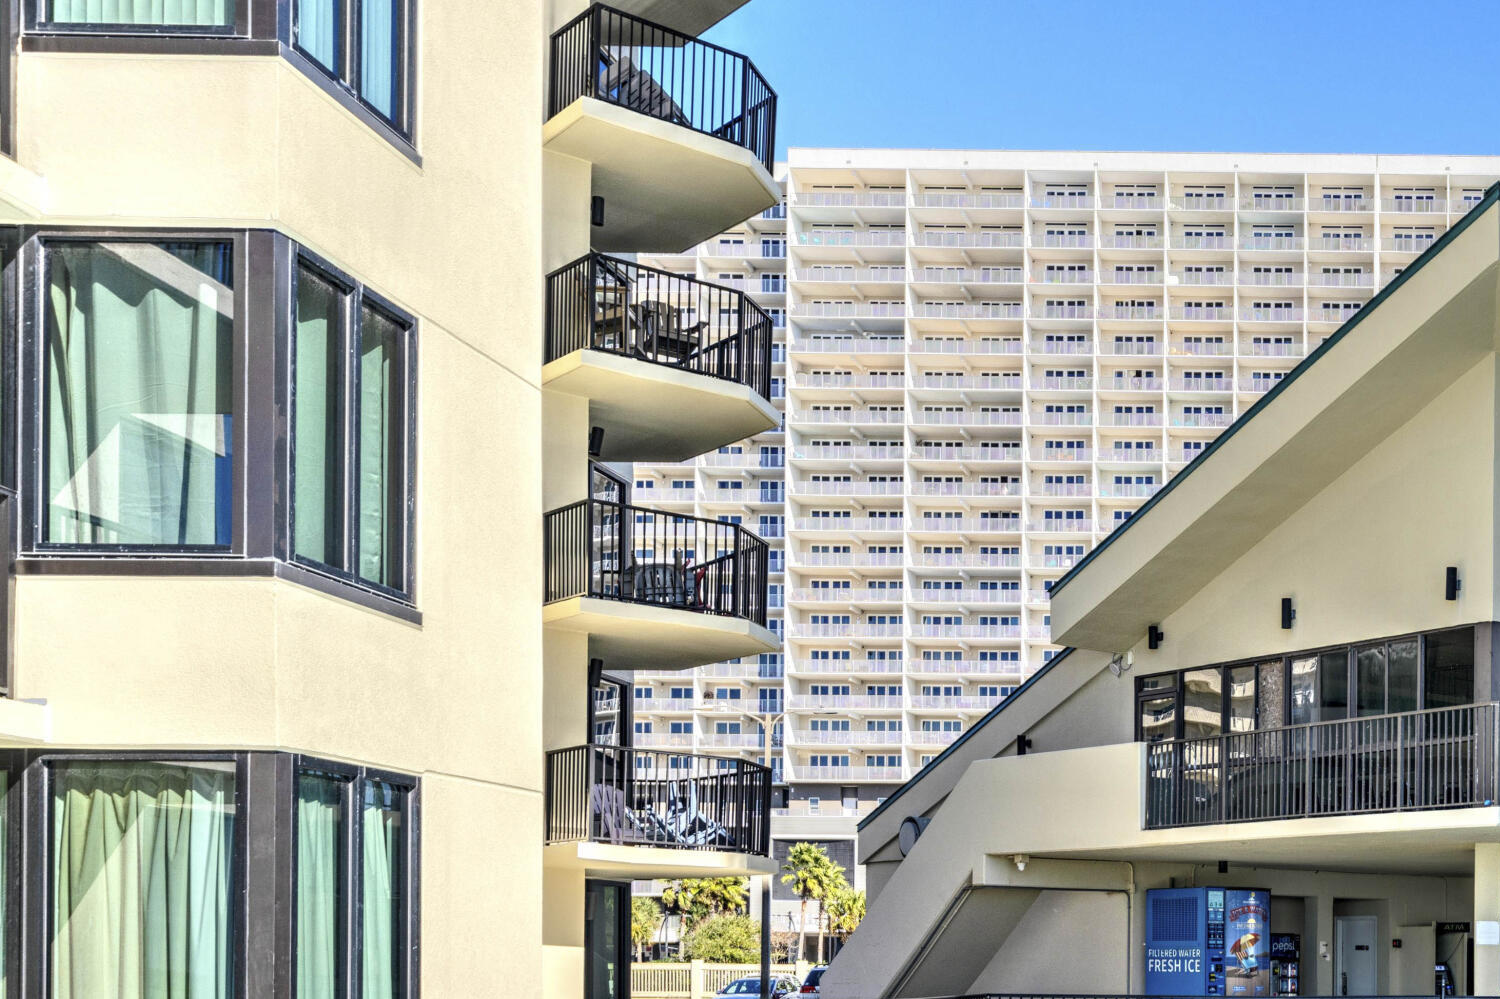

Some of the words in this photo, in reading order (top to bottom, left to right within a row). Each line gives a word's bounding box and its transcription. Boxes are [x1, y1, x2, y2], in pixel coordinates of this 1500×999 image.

[1272, 940, 1295, 951] pepsi
[1148, 948, 1177, 957] FILTERED
[1178, 948, 1201, 957] WATER
[1148, 959, 1181, 973] FRESH
[1184, 959, 1201, 973] ICE
